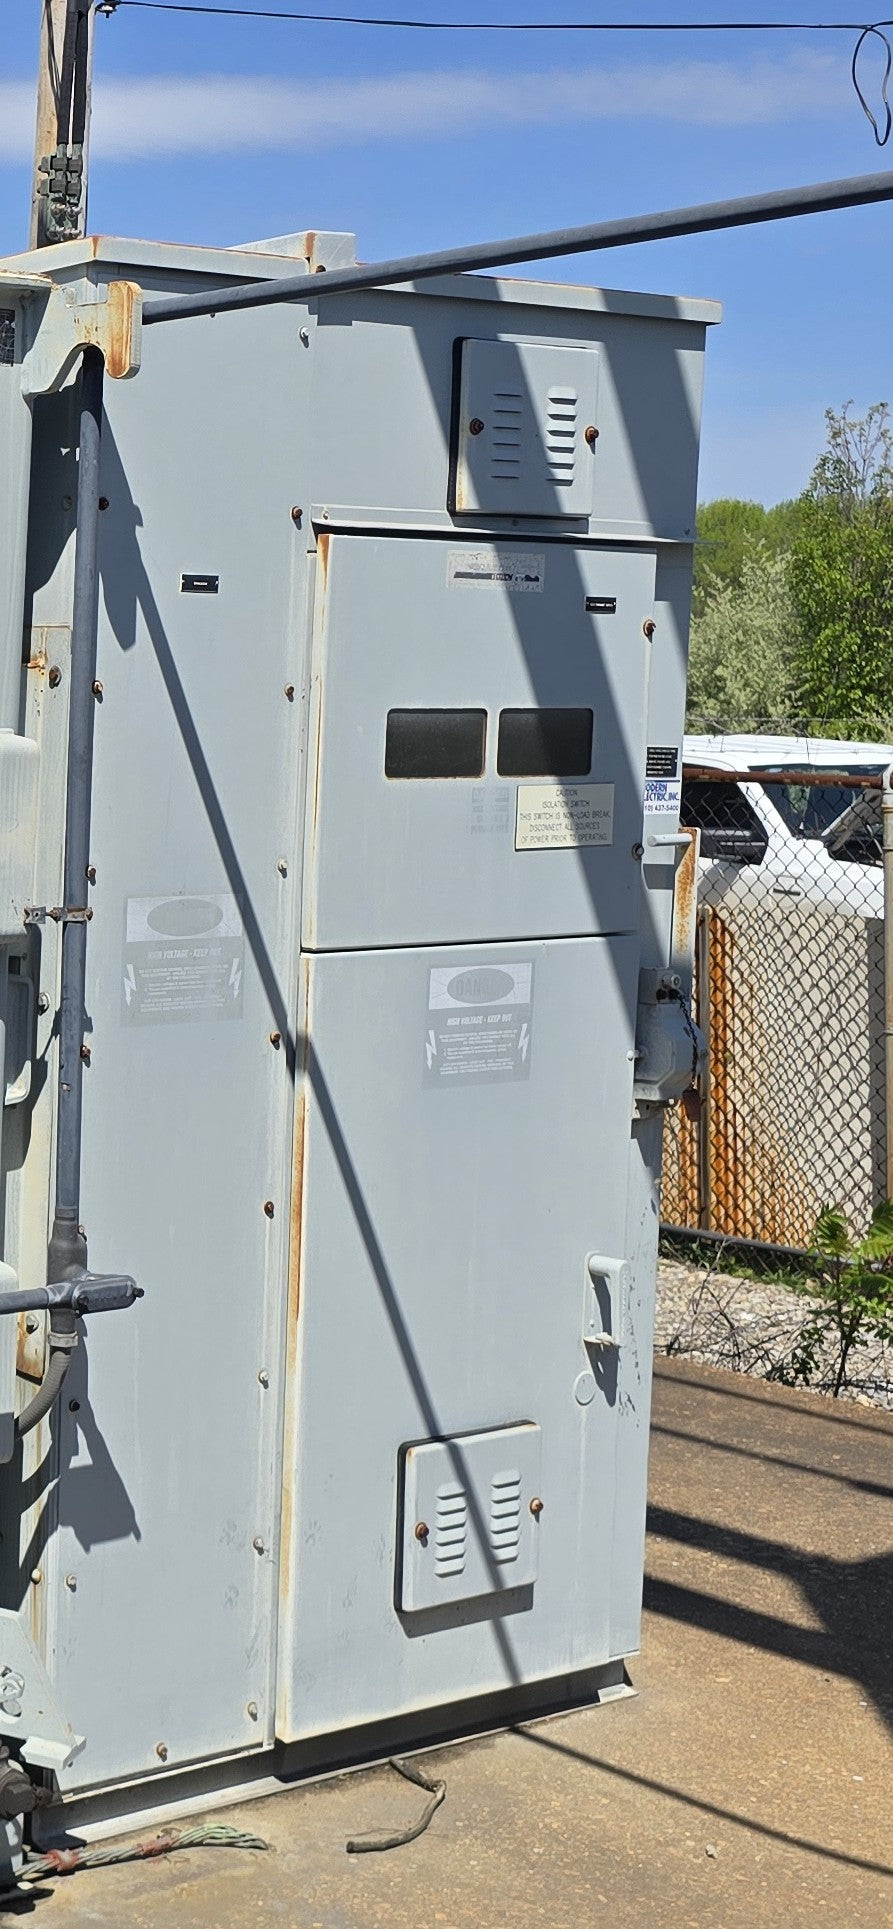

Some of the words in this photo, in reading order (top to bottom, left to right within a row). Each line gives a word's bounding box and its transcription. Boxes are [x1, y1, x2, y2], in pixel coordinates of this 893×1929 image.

[645, 782, 667, 792] ODERN
[555, 788, 578, 797] CAUTION
[542, 800, 569, 809] ISOLATION
[570, 799, 591, 808] SWITCH
[520, 812, 532, 821] THIS
[533, 811, 554, 820] SWITCH
[555, 811, 561, 819] IS
[562, 811, 590, 820] NON-LOAD
[529, 822, 562, 833] DISCONNECT
[564, 821, 573, 831] ALL
[574, 820, 600, 831] SOURCES
[521, 834, 529, 844] OF
[529, 833, 550, 844] POWER
[550, 833, 568, 843] PRIOR
[569, 832, 577, 842] TO
[446, 1017, 460, 1025] HIGH
[460, 1015, 483, 1025] VOLTAGE
[487, 1014, 501, 1023] KEEP
[501, 1013, 513, 1022] OUT
